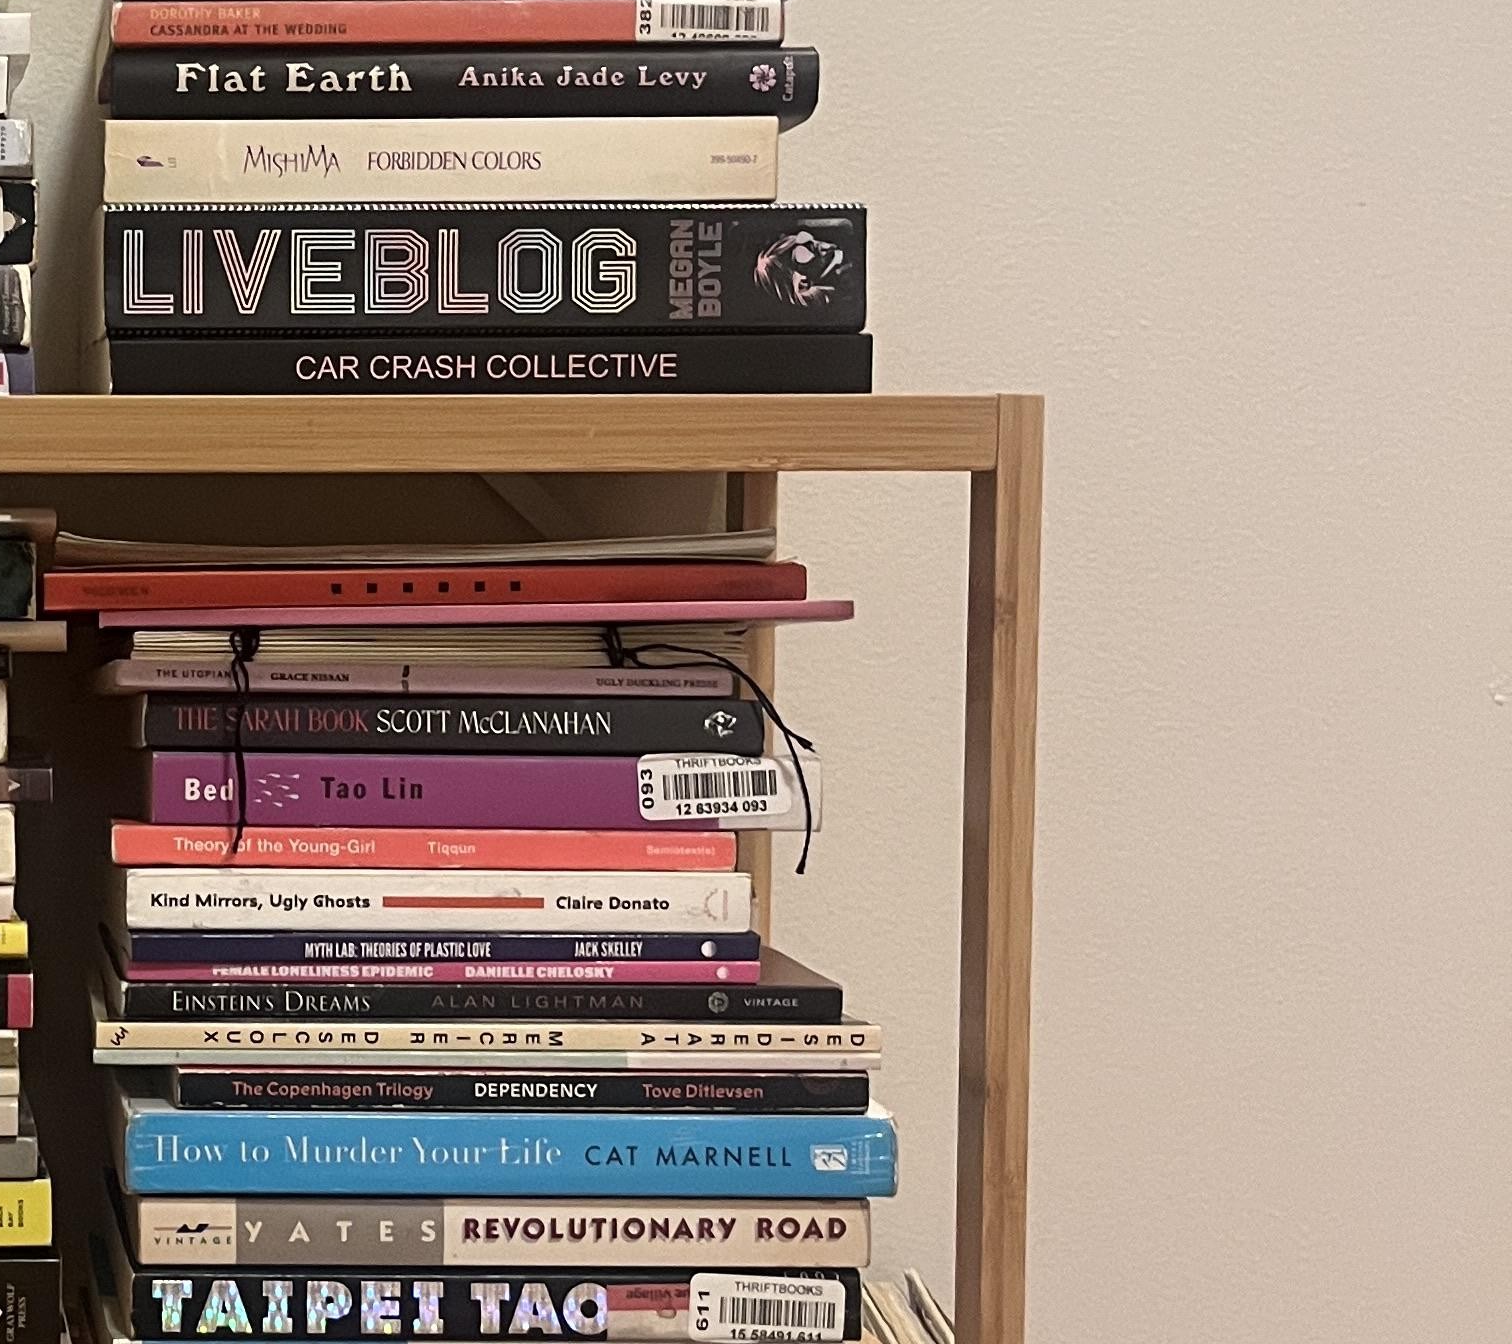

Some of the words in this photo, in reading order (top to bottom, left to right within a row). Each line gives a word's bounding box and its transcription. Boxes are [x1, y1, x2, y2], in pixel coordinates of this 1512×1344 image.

[149, 24, 229, 36] CASSANDRA
[234, 24, 250, 36] AT
[255, 24, 281, 36] THE
[287, 24, 347, 35] WEDDING
[176, 64, 266, 92] Flat
[286, 62, 412, 92] Earth
[458, 67, 544, 87] Anika
[557, 66, 623, 88] Jade
[638, 66, 707, 91] Levy
[367, 151, 467, 171] FORBIDDEN
[471, 151, 542, 172] COLORS
[122, 228, 637, 315] LIVEBLOG
[296, 354, 359, 380] CAR
[369, 355, 476, 380] CRASH
[486, 353, 677, 378] COLLECTIVE
[376, 709, 450, 734] SCOTT
[458, 710, 611, 736] McCLANAHAN
[320, 777, 367, 800] Tao
[382, 777, 423, 800] Lin
[640, 767, 656, 809] 093
[150, 893, 190, 909] Kind
[196, 894, 264, 911] Mirrors,
[270, 893, 311, 912] Ugly
[315, 893, 370, 909] Ghosts
[556, 895, 604, 910] Claire
[609, 895, 670, 910] Donato
[574, 941, 600, 956] JACK
[601, 942, 643, 957] SKELLEY
[232, 1083, 268, 1097] The
[267, 1081, 372, 1100] Copenhagen
[376, 1082, 433, 1102] Trilogy
[474, 1083, 598, 1099] DEPENDENCY
[642, 1083, 681, 1099] Tove
[687, 1083, 763, 1099] Ditlevsen
[586, 1146, 644, 1168] CAT
[657, 1146, 793, 1167] MARNELL
[463, 1217, 736, 1242] REVOLUTIONARY
[757, 1217, 848, 1241] ROAD
[734, 1281, 823, 1296] THRIFTBOOKS
[151, 1280, 444, 1333] TAIPEI
[697, 1289, 709, 1331] 611
